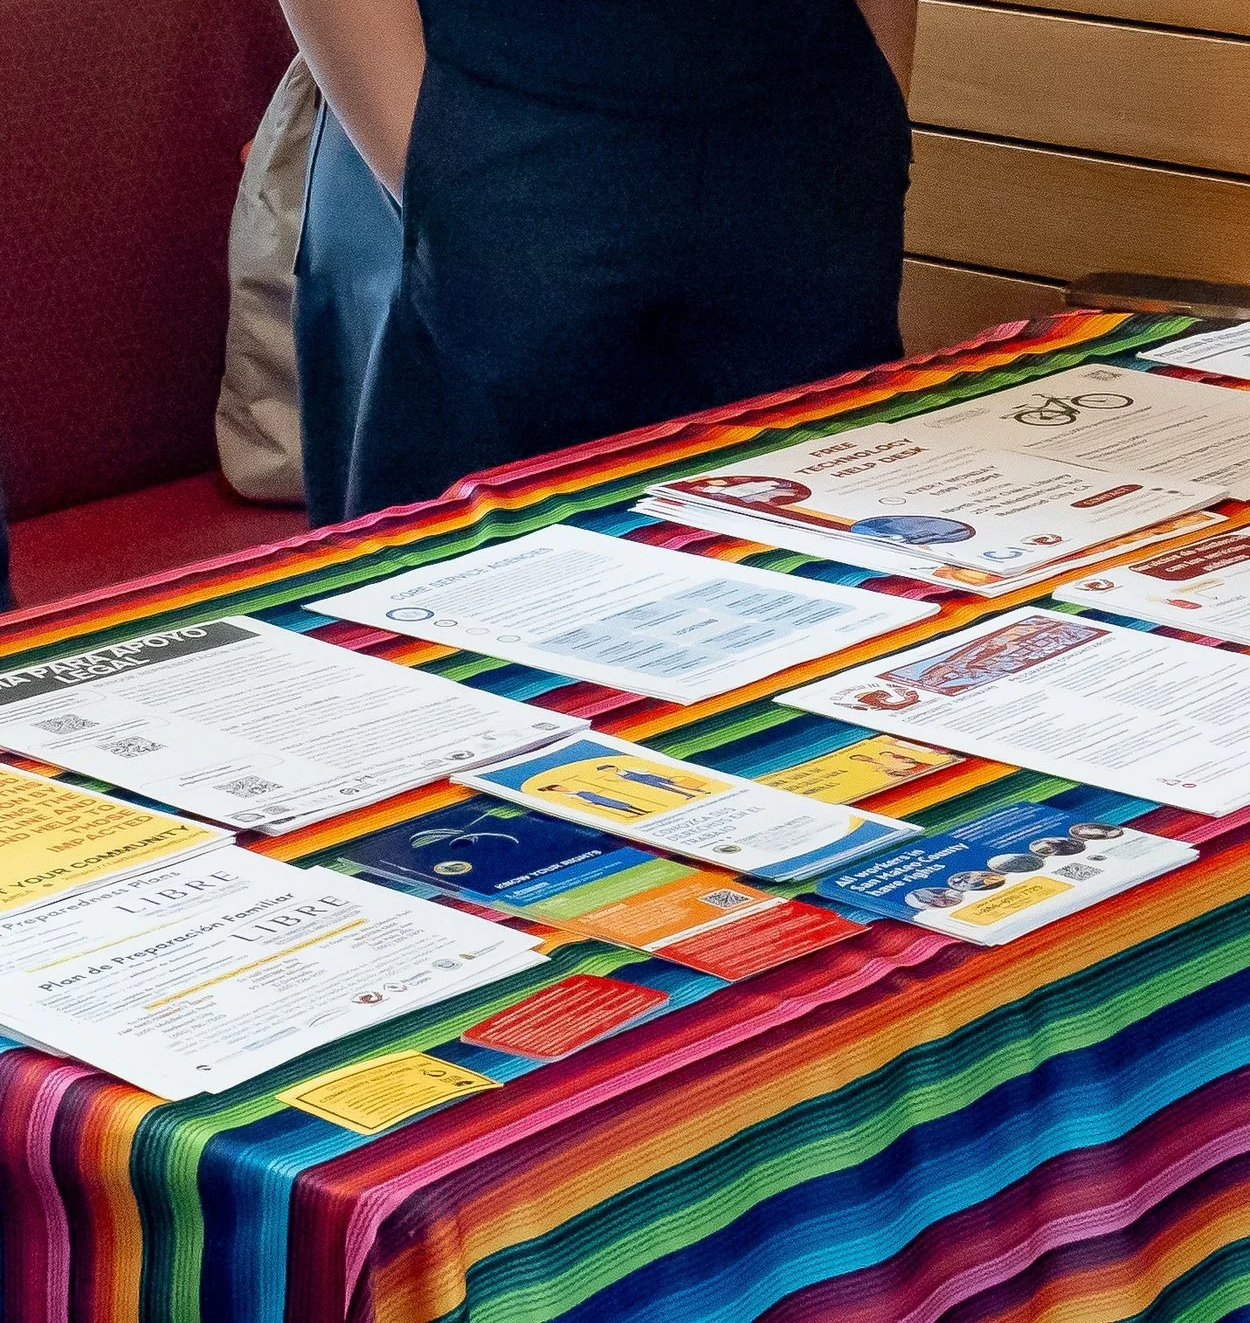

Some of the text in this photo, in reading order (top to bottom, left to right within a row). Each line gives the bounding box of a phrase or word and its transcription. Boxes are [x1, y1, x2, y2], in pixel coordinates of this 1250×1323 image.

[794, 437, 913, 475] TECHNOLOGY
[808, 441, 858, 458] FREE
[830, 446, 929, 478] HELP DESK
[390, 546, 554, 601] CORE SERVICE AGENCIES
[26, 654, 113, 679] PARA
[110, 626, 208, 657] APOYO
[53, 655, 151, 685] LEGAL
[28, 786, 58, 799] BY
[35, 792, 82, 808] THE
[53, 798, 97, 815] AND
[30, 815, 82, 834] HELP
[83, 803, 117, 815] TO
[46, 814, 154, 853] IMPACTED
[63, 807, 137, 834] THOSE
[9, 867, 73, 888] YOUR
[70, 824, 190, 869] COMMUNITY
[494, 849, 602, 890] KNOW YOUR RIGHTS
[834, 849, 926, 888] All workers in
[850, 842, 970, 892] San Mateo County
[114, 870, 240, 915] LIBRE
[864, 864, 946, 897] have rights
[1, 888, 130, 931] Preparedness
[127, 870, 183, 894] Plans
[230, 894, 351, 943] LIBRE
[37, 892, 295, 993] Plan de Preparación Familiar
